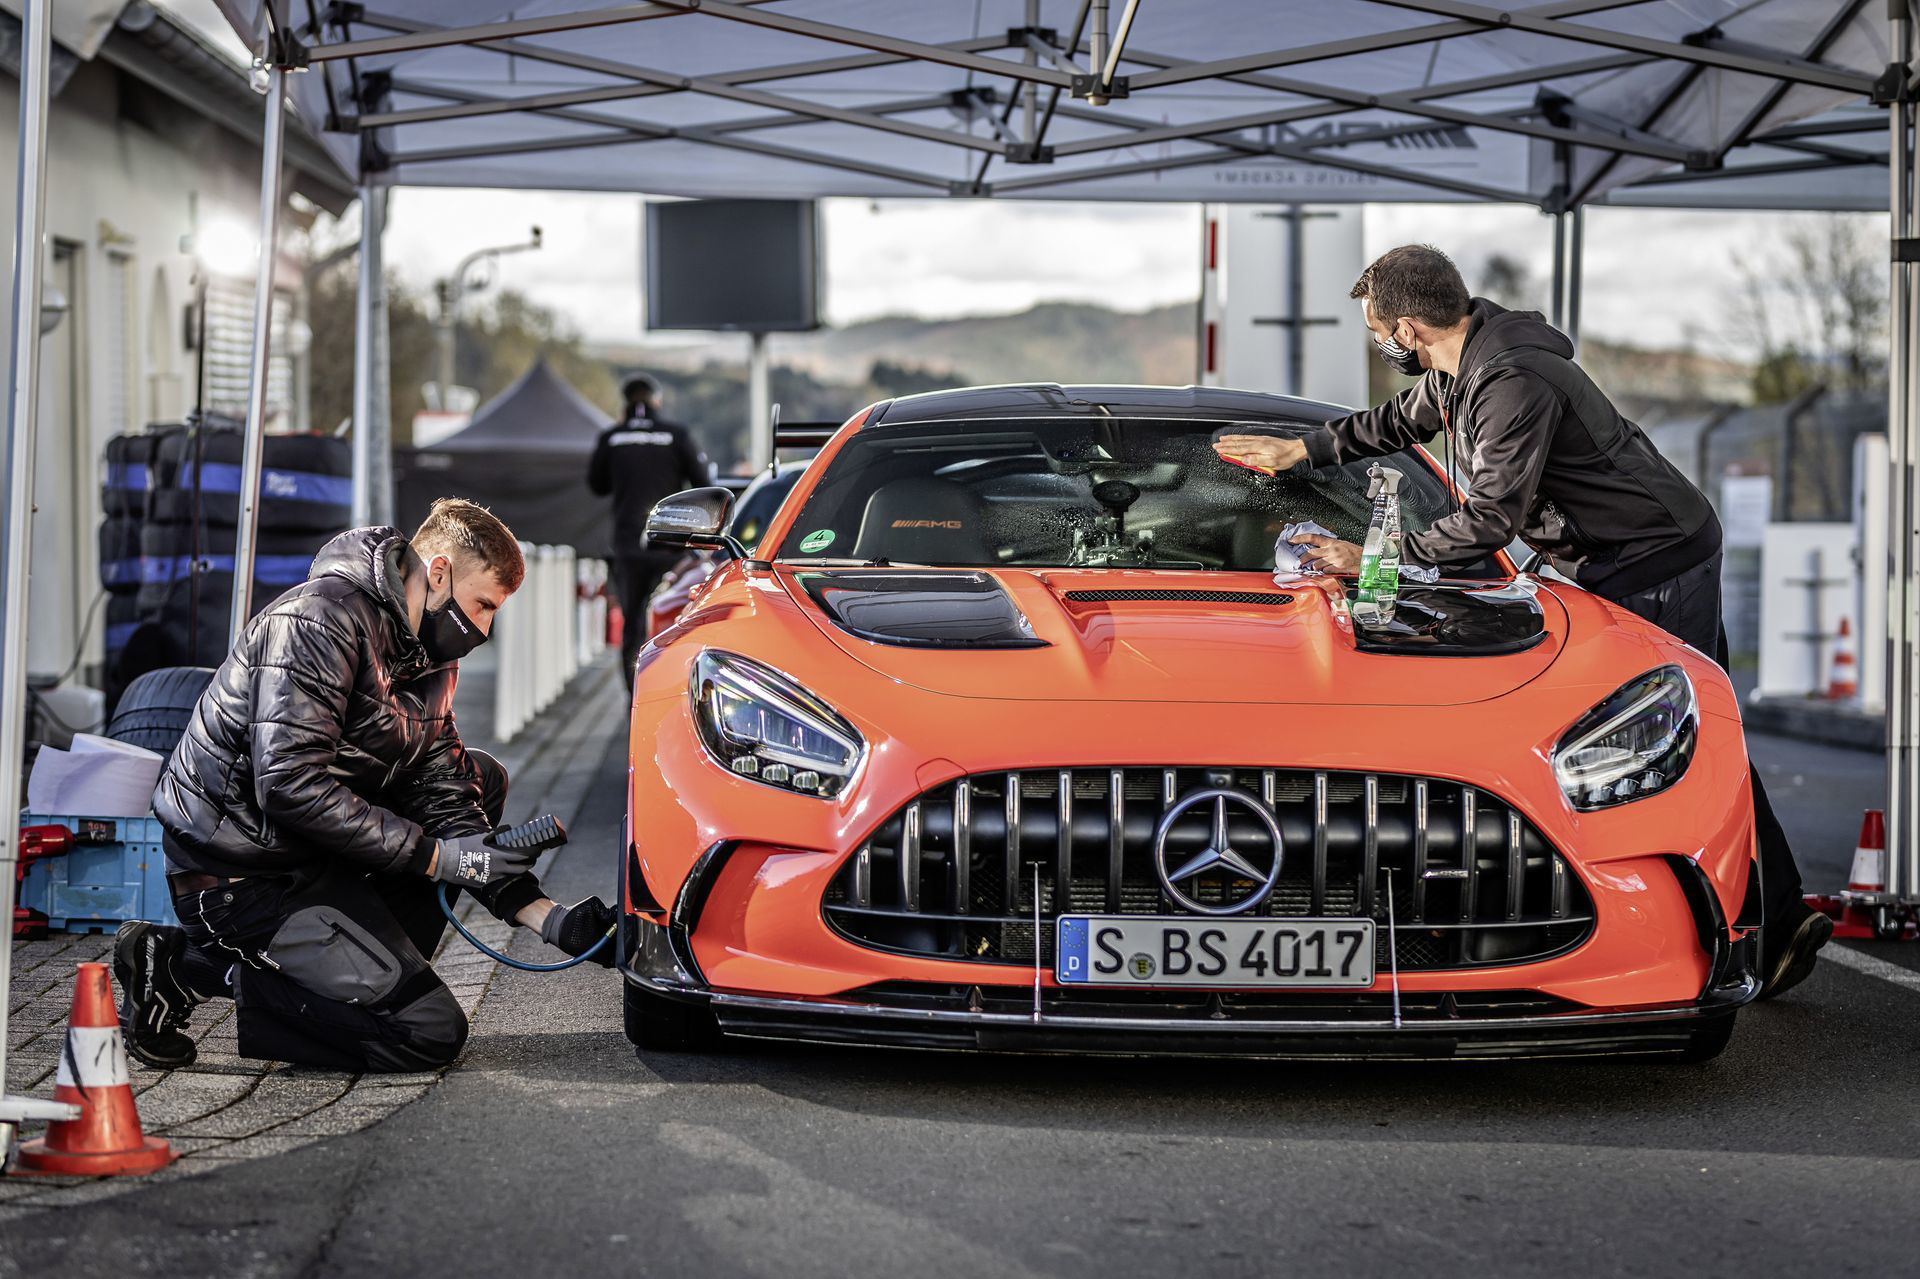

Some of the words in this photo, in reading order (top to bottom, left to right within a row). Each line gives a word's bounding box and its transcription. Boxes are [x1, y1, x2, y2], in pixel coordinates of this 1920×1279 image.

[915, 519, 963, 529] AMG
[814, 530, 824, 541] 4
[482, 852, 490, 884] MaxiFlex
[1094, 926, 1125, 974] S
[1162, 927, 1228, 976] BS
[1240, 928, 1364, 977] 4017
[1068, 956, 1080, 971] D
